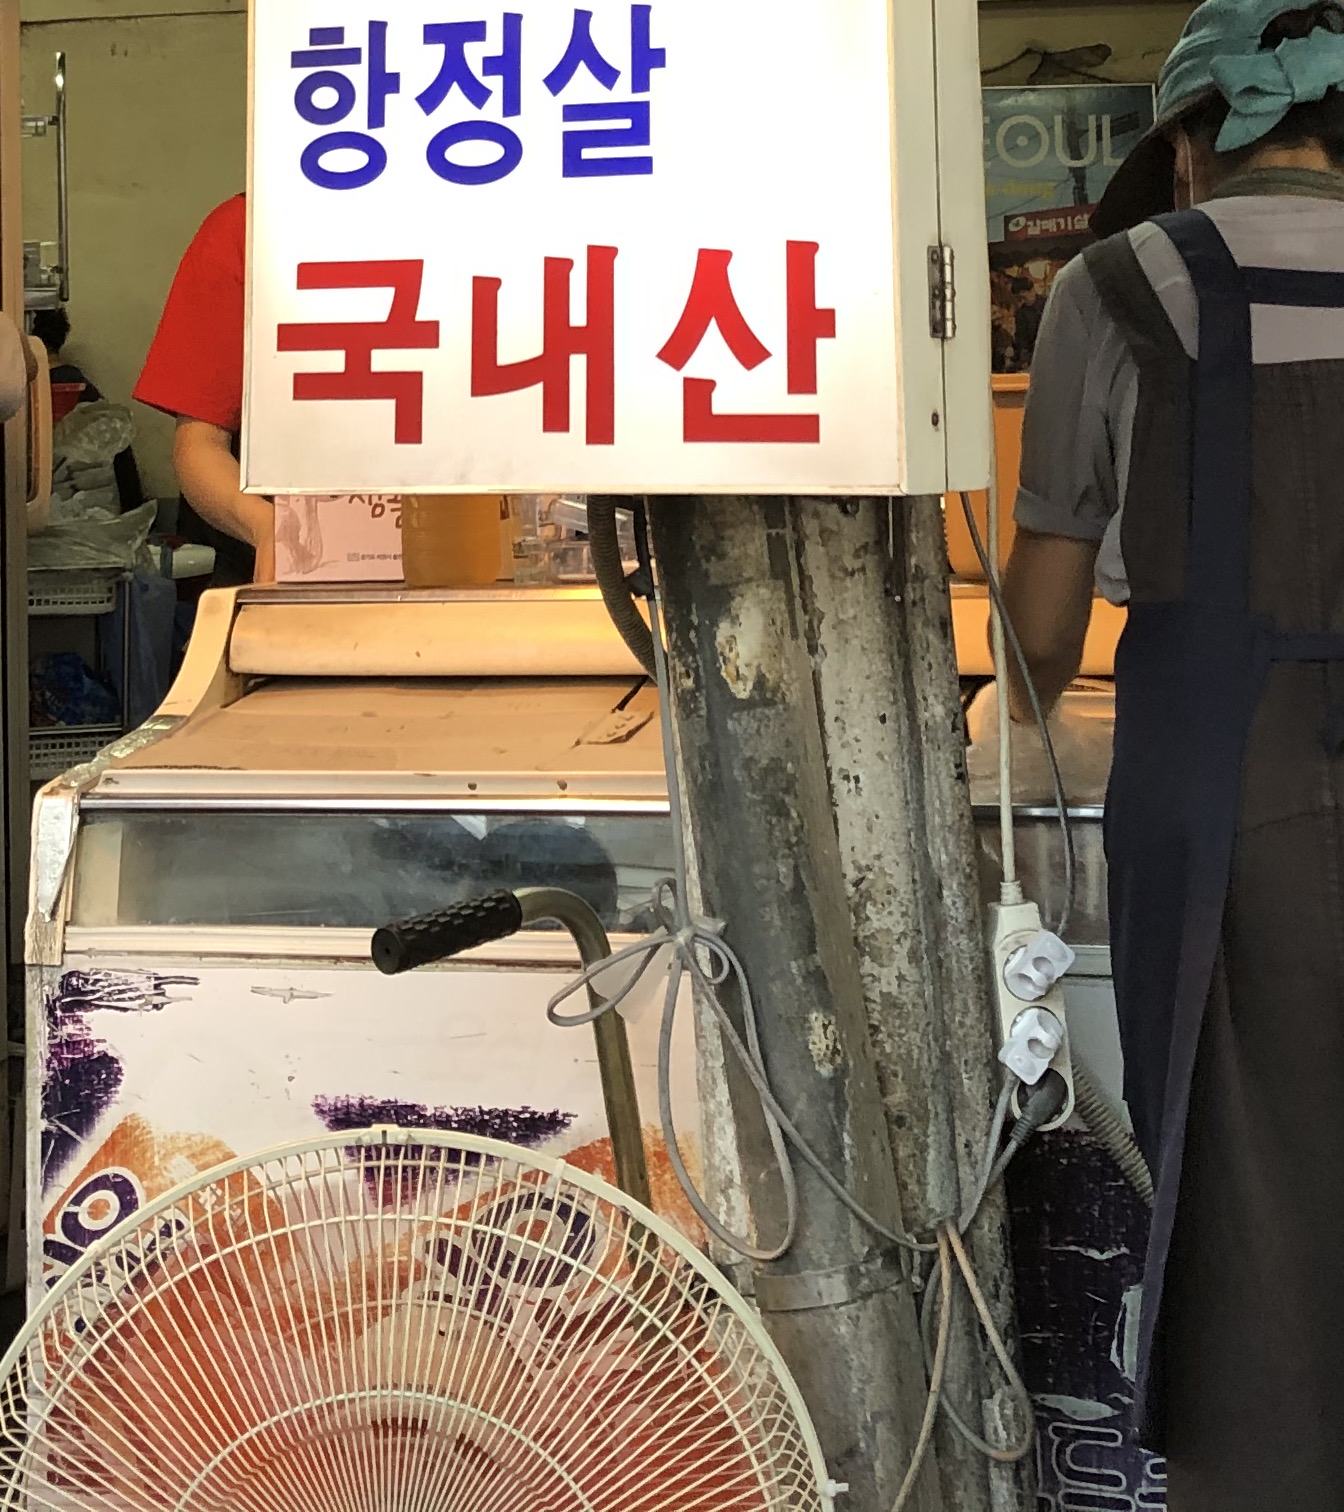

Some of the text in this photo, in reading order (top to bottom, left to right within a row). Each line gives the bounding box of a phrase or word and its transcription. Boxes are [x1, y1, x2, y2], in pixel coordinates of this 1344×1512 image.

[291, 4, 666, 191] 항정살
[984, 114, 1124, 168] OUL
[276, 240, 836, 446] 국내산
